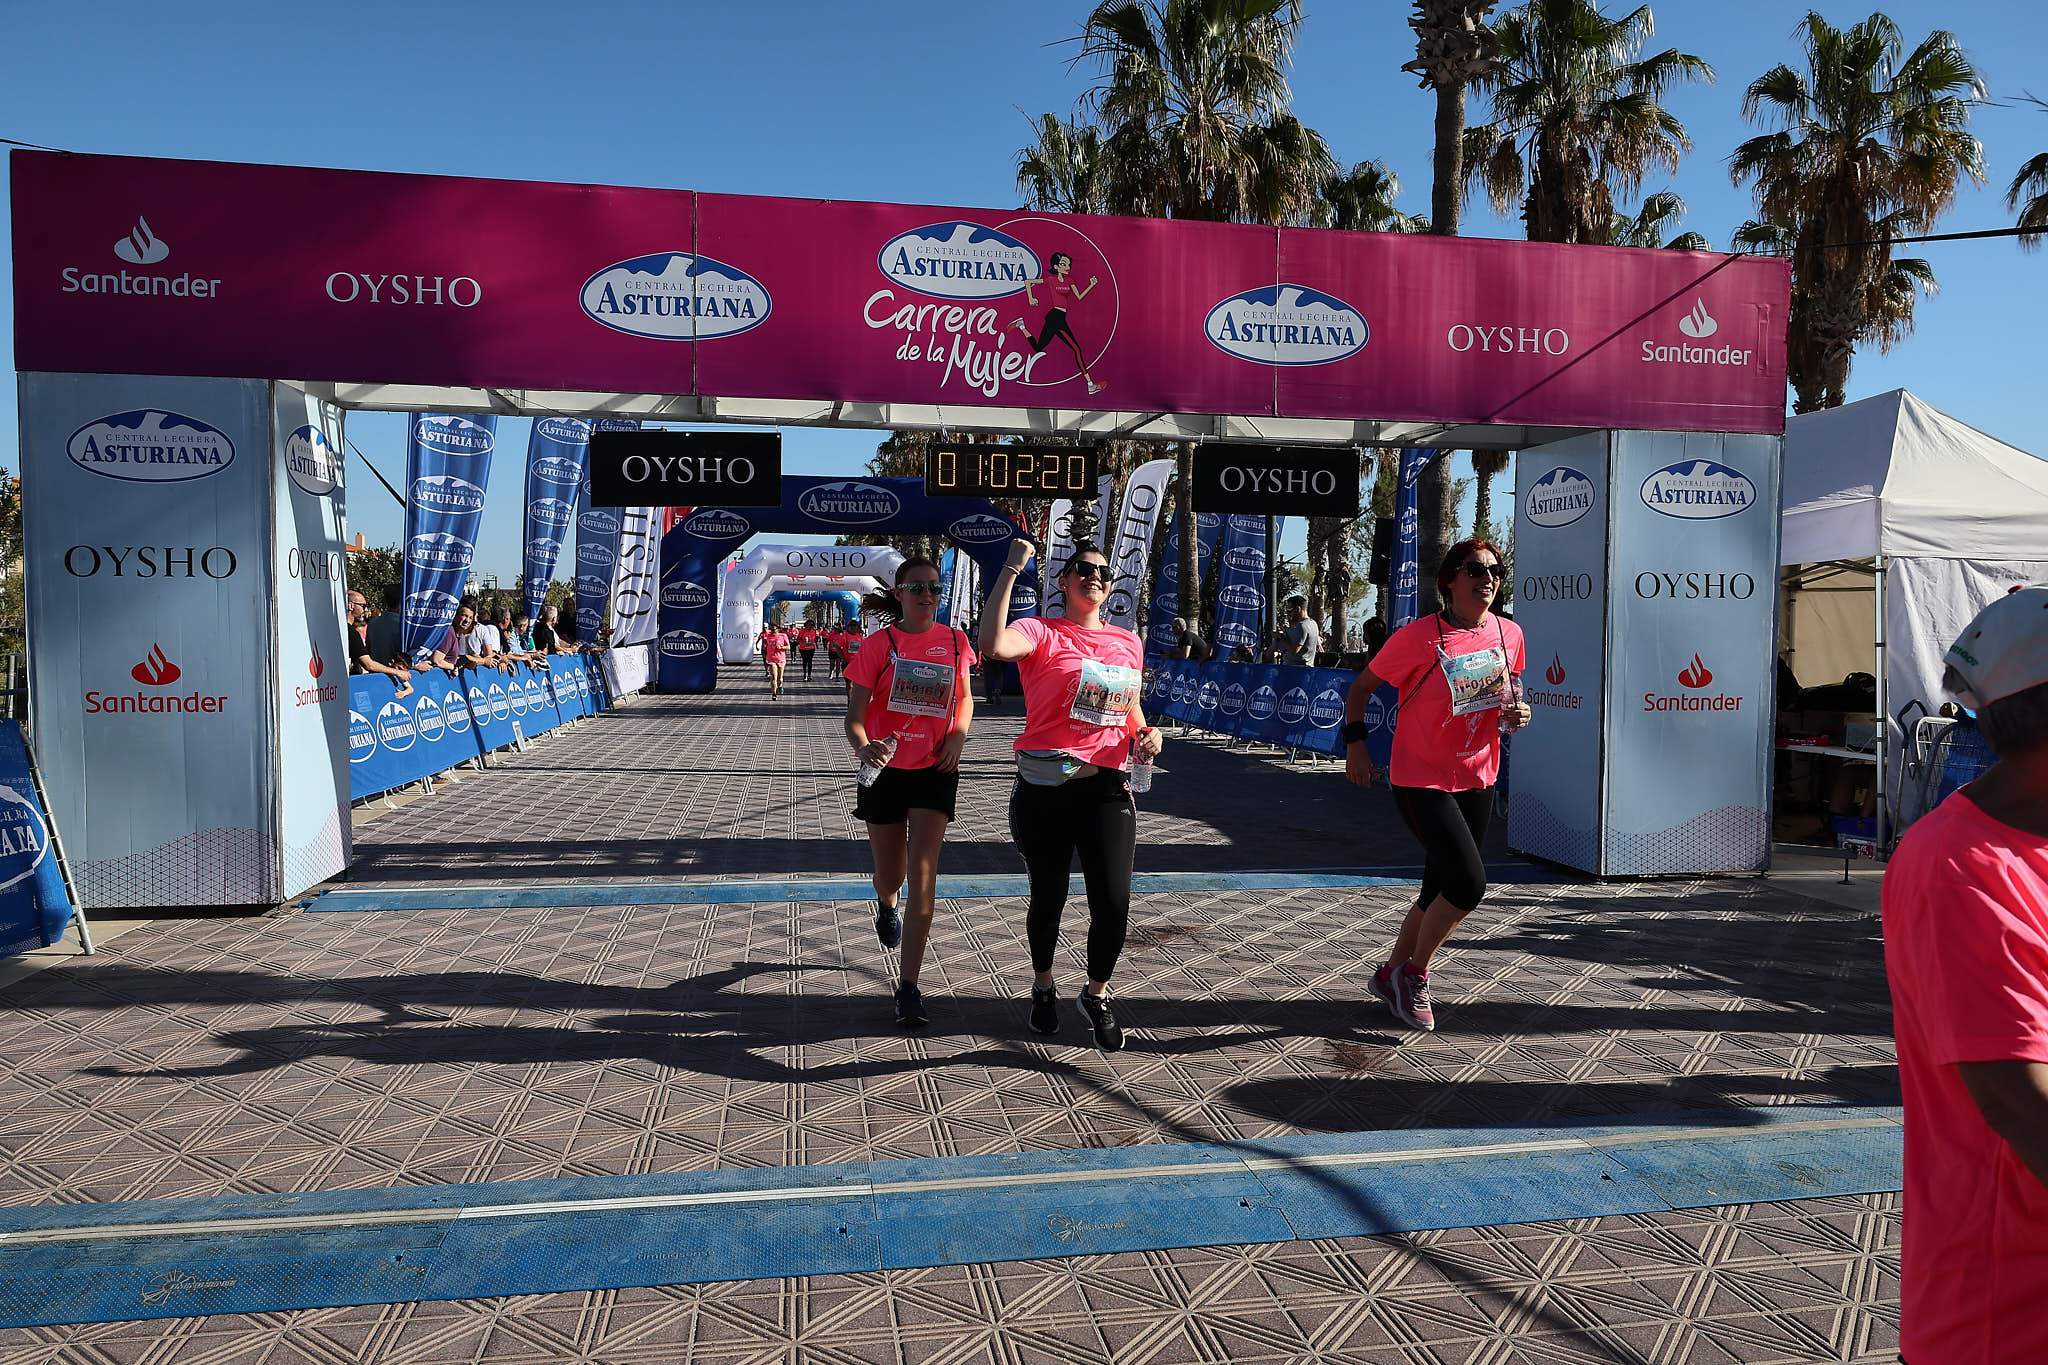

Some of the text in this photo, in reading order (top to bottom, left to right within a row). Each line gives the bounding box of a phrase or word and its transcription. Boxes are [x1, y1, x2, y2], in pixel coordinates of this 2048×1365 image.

[891, 246, 1028, 281] ASTURIANA
[916, 245, 1025, 260] CENTRAL LECHERA
[61, 267, 222, 298] Santander
[325, 271, 482, 307] OYSHO
[624, 280, 685, 291] CENTRAL
[594, 281, 758, 319] ASTURIANA
[863, 289, 998, 336] Carrera
[1217, 311, 1357, 346] ASTURIANA
[1243, 310, 1351, 323] CENTRAL LECHERA
[1447, 323, 1570, 356] OYSHO
[896, 332, 1047, 398] de la Mujer
[1641, 339, 1752, 367] Santander
[105, 433, 217, 444] CENTRAL LECHERA
[418, 424, 489, 449] ASTURIANA
[80, 434, 223, 465] ASTURIANA
[290, 444, 337, 482] ASTURIANA
[622, 455, 755, 485] OYSHO
[938, 452, 1085, 489] 01:02:20
[1219, 466, 1336, 495] OYSHO
[1648, 480, 1747, 505] ASTURIANA
[1666, 479, 1744, 488] CENTRAL LECHERA
[414, 484, 482, 508] ASTURIANA
[806, 493, 893, 513] ASTURIANA
[1529, 492, 1589, 516] ASTURIANA
[688, 519, 744, 533] ASTURIANA
[954, 525, 1009, 537] ASTURIANA
[1232, 517, 1266, 531] ASTURIA
[64, 545, 238, 579] OYSHO
[409, 543, 471, 564] ASTURIANA
[786, 551, 866, 568] OYSHO
[1106, 484, 1158, 616] OYSHO
[288, 547, 342, 581] OYSHO
[615, 512, 649, 619] OYSH
[662, 591, 707, 603] ASTURIANA
[1523, 573, 1593, 601] OYSHO
[1634, 571, 1755, 600] OYSHO
[661, 640, 706, 651] ASTURIANA
[85, 691, 228, 713] Santander
[295, 684, 338, 707] Santander
[1527, 687, 1583, 710] Santander
[1644, 693, 1743, 712] Santander
[1311, 707, 1341, 720] ASTURIANA
[381, 721, 416, 742] ASTURIANA
